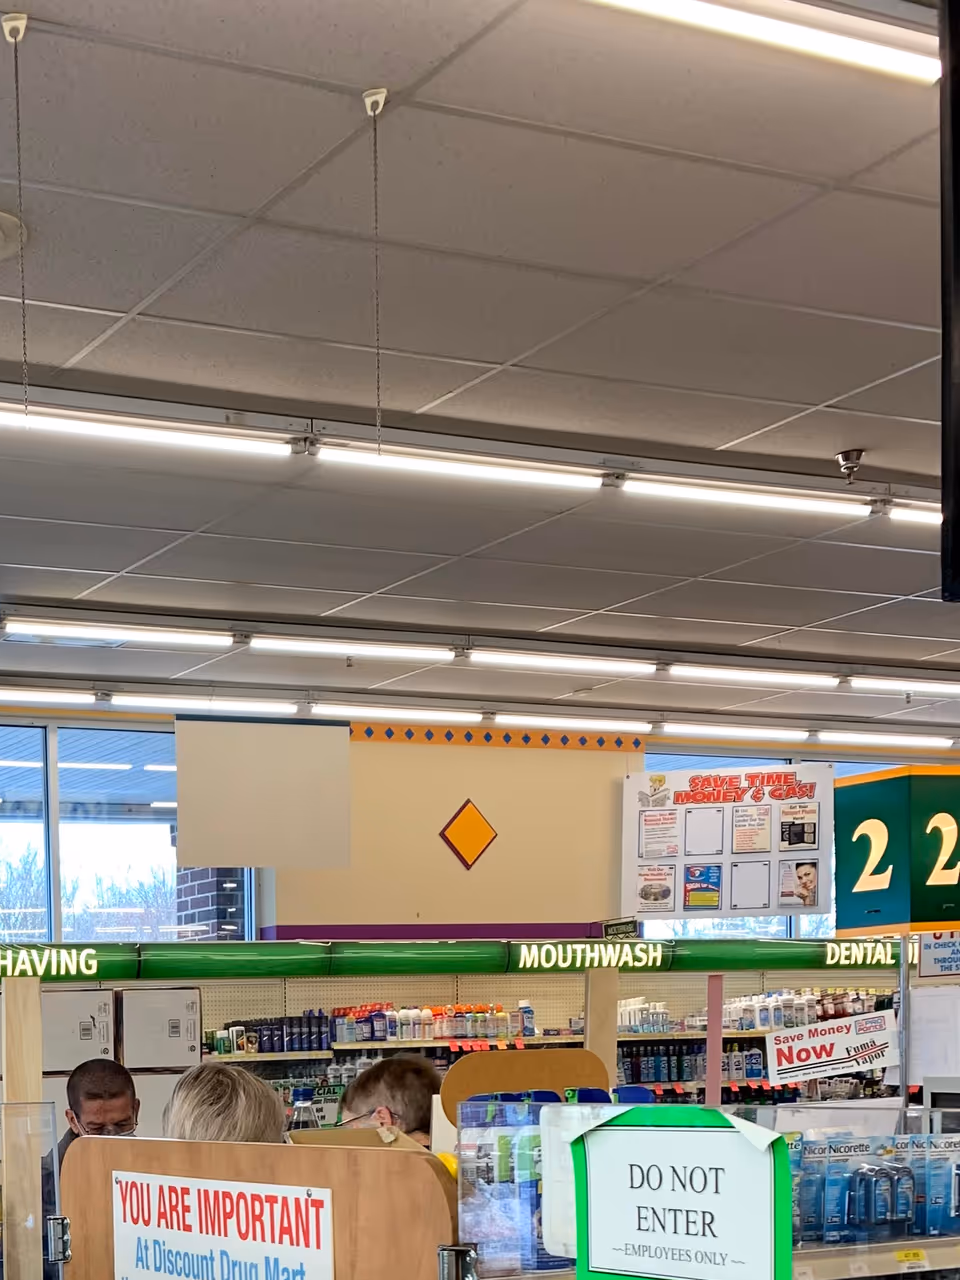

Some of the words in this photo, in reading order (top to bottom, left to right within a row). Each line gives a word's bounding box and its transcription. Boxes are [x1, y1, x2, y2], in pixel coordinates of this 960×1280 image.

[673, 787, 748, 804] MONEY
[768, 782, 816, 800] GAS!
[689, 775, 741, 790] SAVE
[852, 818, 893, 893] 2
[925, 812, 960, 885] 2
[518, 943, 662, 969] MOUTHWASH
[826, 942, 896, 965] DENTAL
[774, 1033, 804, 1045] Save
[808, 1024, 852, 1039] Money
[776, 1042, 835, 1067] Now
[854, 1049, 886, 1067] Vapor
[828, 1143, 870, 1154] Nicorette
[628, 1164, 662, 1191] DO
[670, 1165, 726, 1195] NOT
[117, 1180, 152, 1228] YOU
[156, 1184, 192, 1233] ARE
[197, 1188, 325, 1250] IMPORTANT
[636, 1205, 718, 1238] ENTER
[135, 1236, 149, 1270] At
[695, 1250, 728, 1267] ONLY
